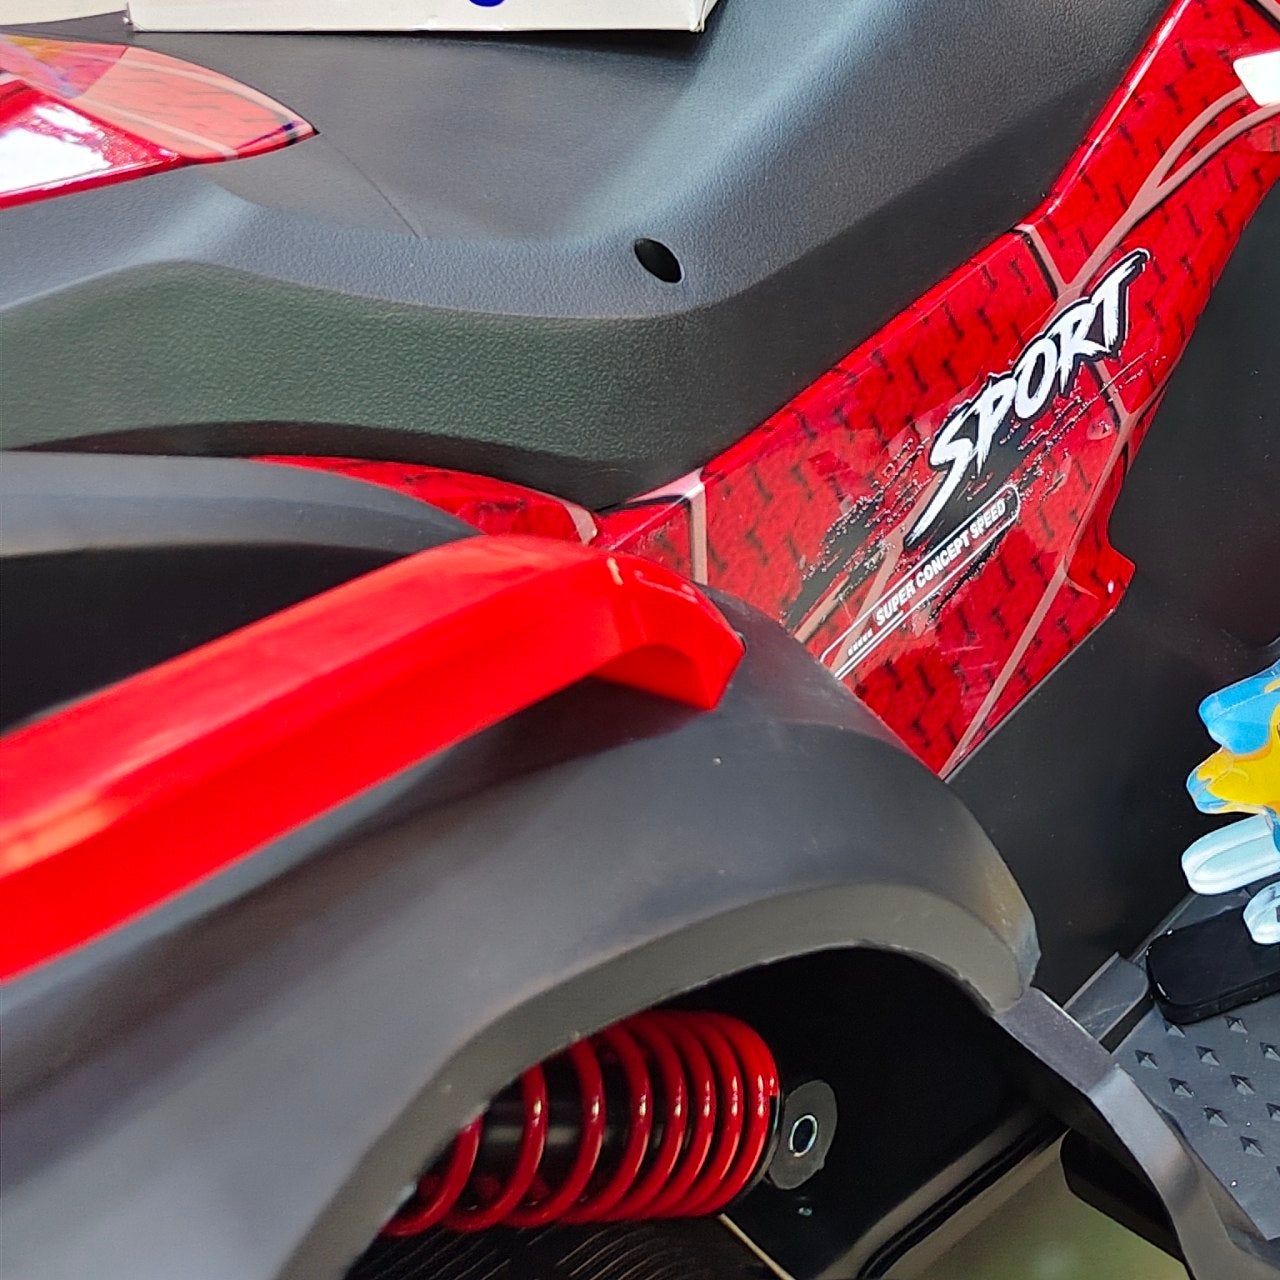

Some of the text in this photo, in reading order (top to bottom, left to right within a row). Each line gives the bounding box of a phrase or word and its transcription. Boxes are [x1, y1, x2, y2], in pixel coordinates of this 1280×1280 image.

[904, 248, 1150, 548] SPORT
[875, 498, 1006, 626] SUPER CONCEPT SPEED
